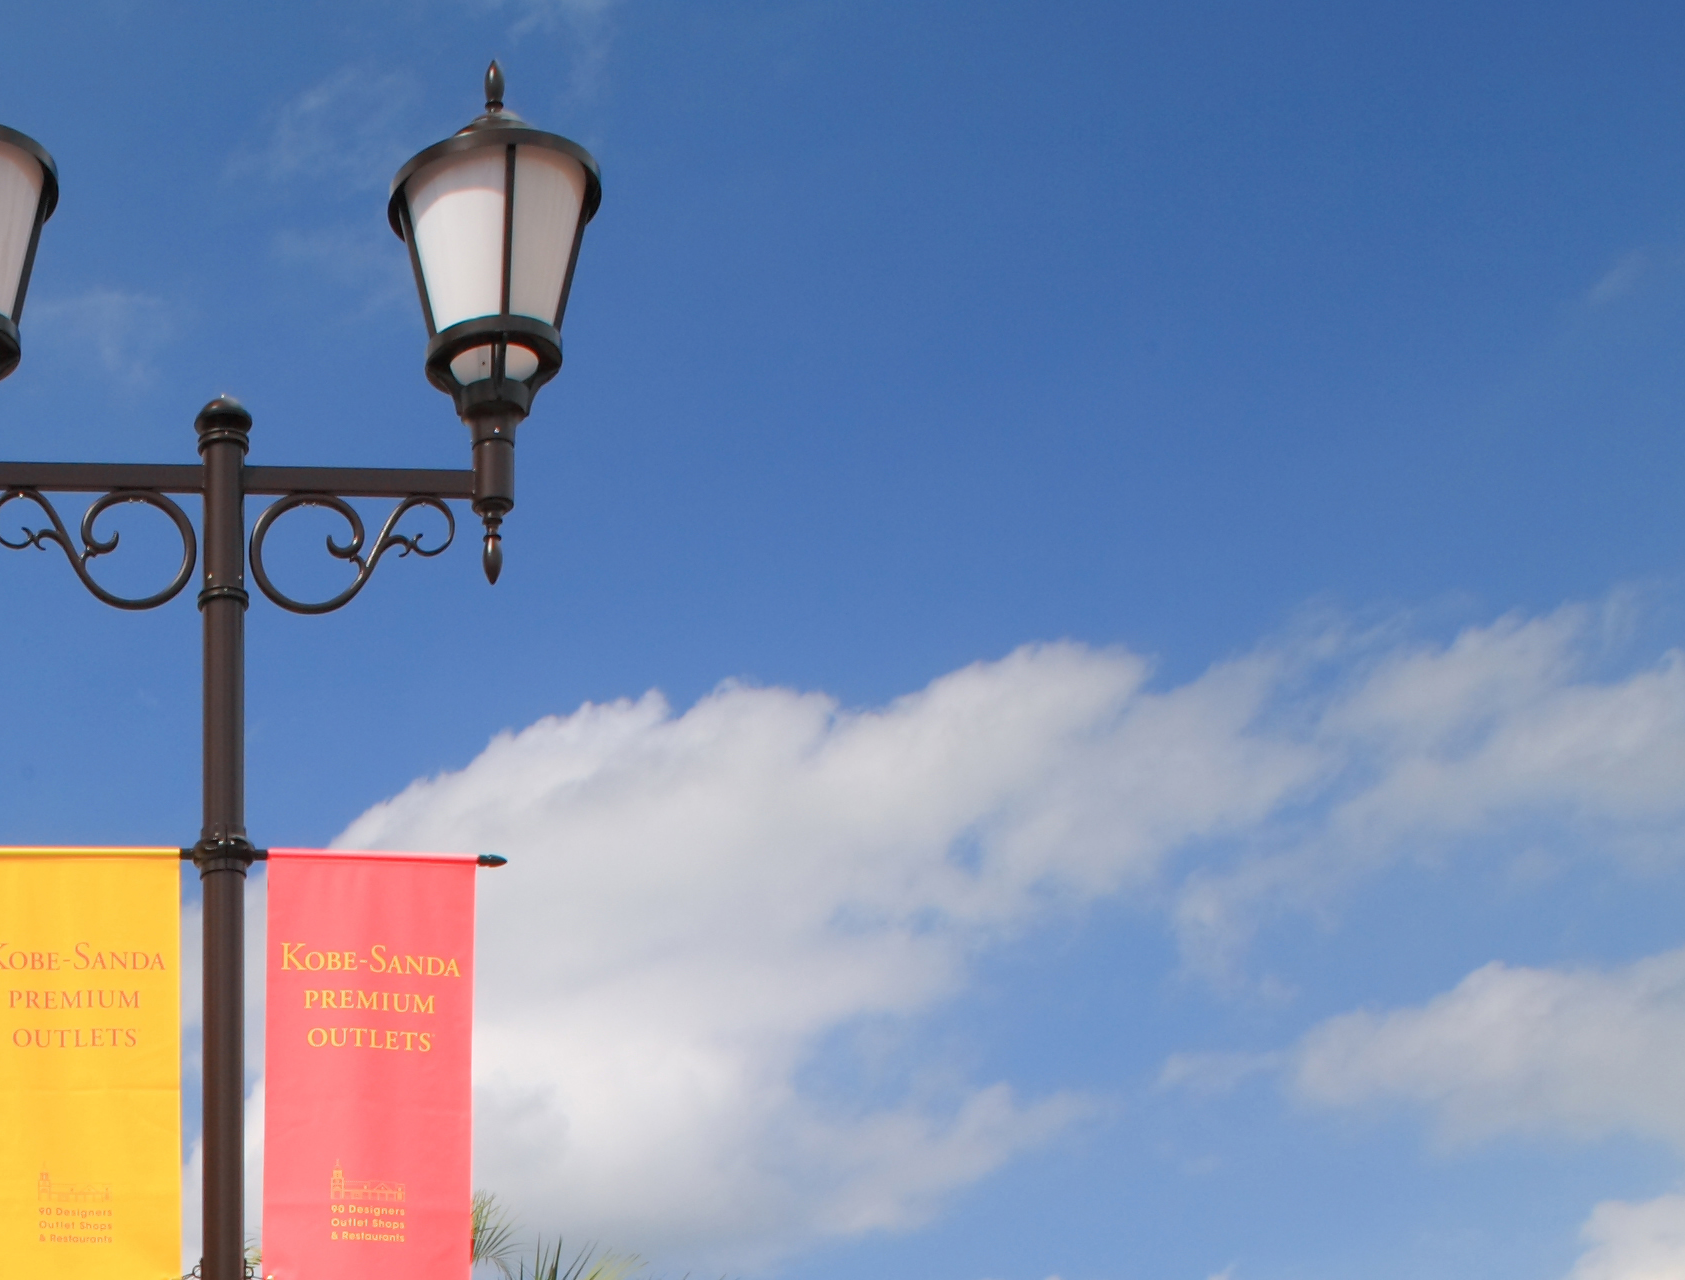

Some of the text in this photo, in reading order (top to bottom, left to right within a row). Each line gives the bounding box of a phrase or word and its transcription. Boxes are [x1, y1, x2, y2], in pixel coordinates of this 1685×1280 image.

[281, 942, 461, 977] KOBE-SANDA
[8, 989, 140, 1010] PREMIUM
[304, 989, 435, 1014] PREMIUM
[12, 1028, 137, 1048] OUTLETS
[307, 1027, 432, 1052] OUTLETS
[39, 1207, 112, 1219] 90 Designers
[331, 1204, 405, 1216] 90 Designers
[39, 1220, 112, 1231] Outlet Shops
[331, 1218, 405, 1230] Outlet Shops
[39, 1234, 113, 1244] & Restaurants
[331, 1231, 405, 1242] & Restaurants
